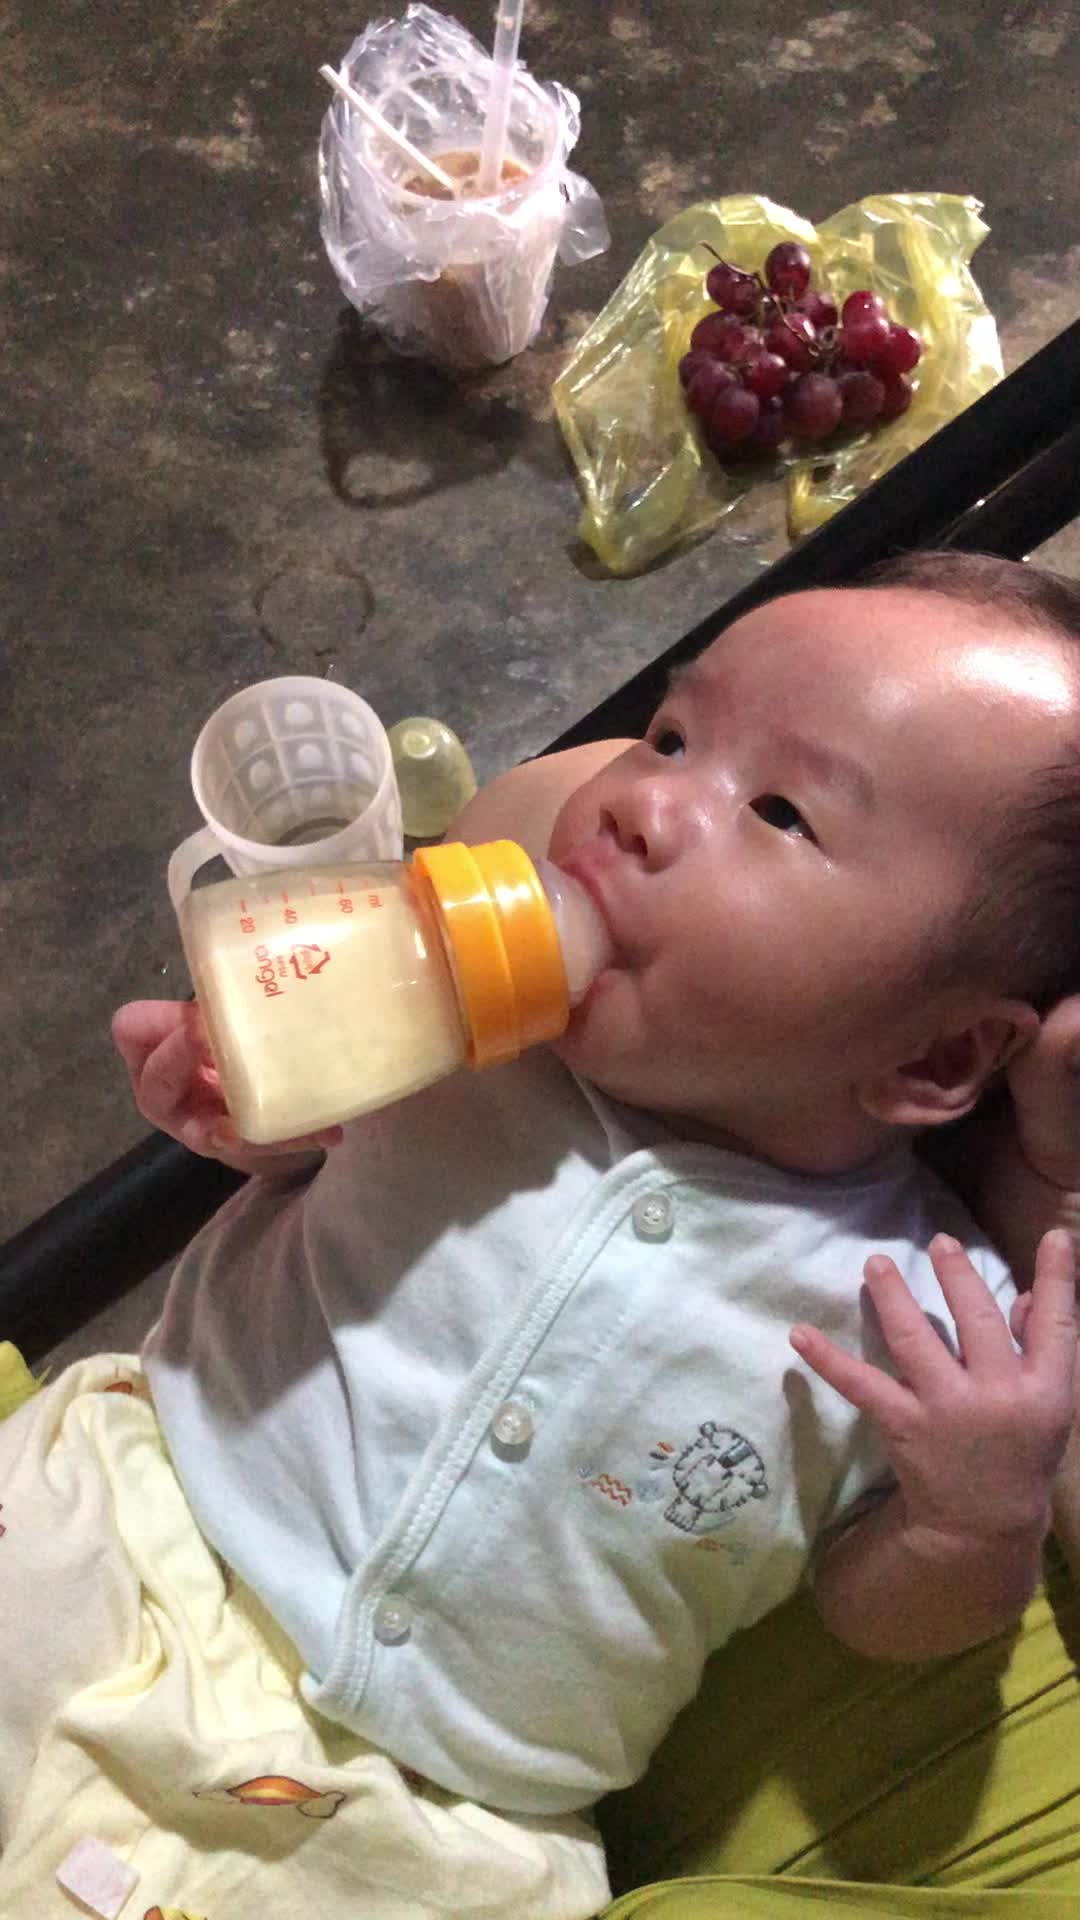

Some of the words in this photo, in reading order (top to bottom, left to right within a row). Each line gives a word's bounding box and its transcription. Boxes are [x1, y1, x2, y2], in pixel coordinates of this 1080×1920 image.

[284, 909, 298, 924] 40
[239, 917, 256, 934] 20
[255, 944, 284, 998] angel
